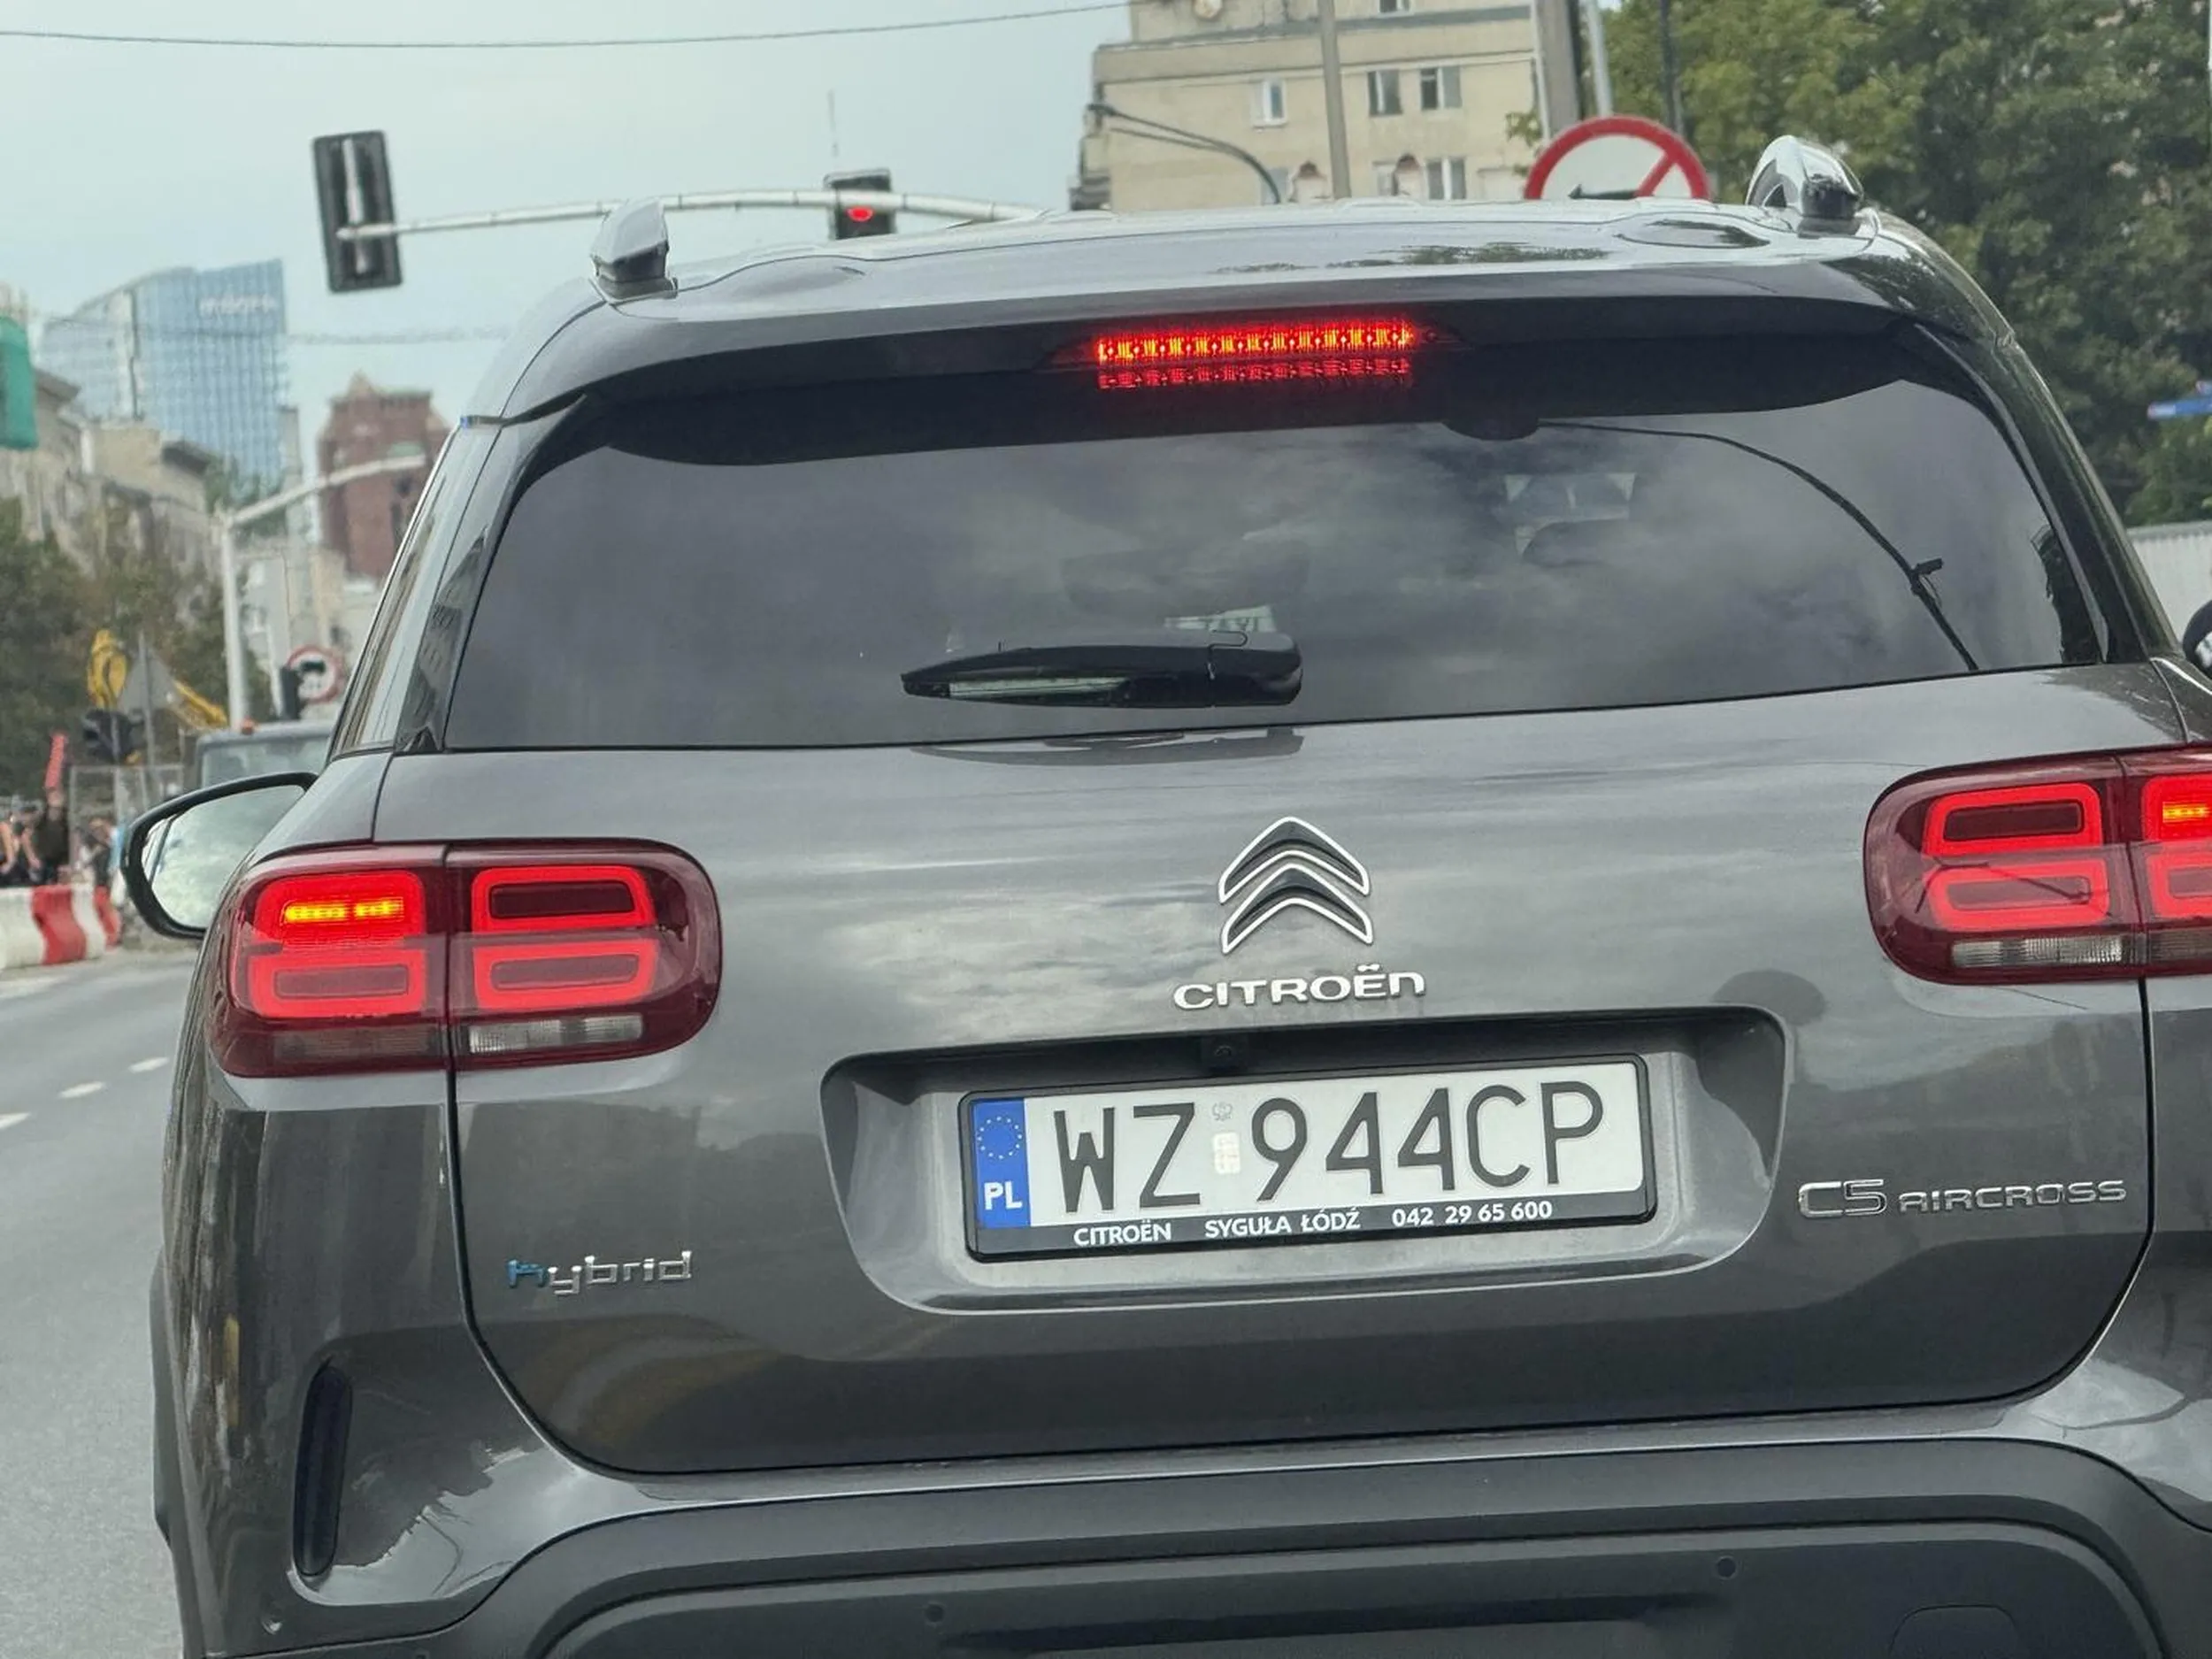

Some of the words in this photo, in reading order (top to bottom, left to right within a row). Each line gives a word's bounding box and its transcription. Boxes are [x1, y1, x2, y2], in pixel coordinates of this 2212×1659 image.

[1054, 1102, 1201, 1213] WZ
[1251, 1080, 1604, 1202] 944CP
[984, 1181, 1023, 1211] PL
[1798, 1179, 1888, 1217] C5
[1899, 1179, 2126, 1212] AIRCROSS
[1073, 1219, 1171, 1246] CITROËN
[1204, 1215, 1292, 1239] SYGUŁA
[1301, 1207, 1361, 1233] ŁÓDŹ
[1392, 1207, 1434, 1227] 042
[1445, 1205, 1471, 1225] 29
[1478, 1203, 1505, 1223] 65
[1511, 1200, 1553, 1220] 600
[508, 1250, 692, 1295] hybrid
